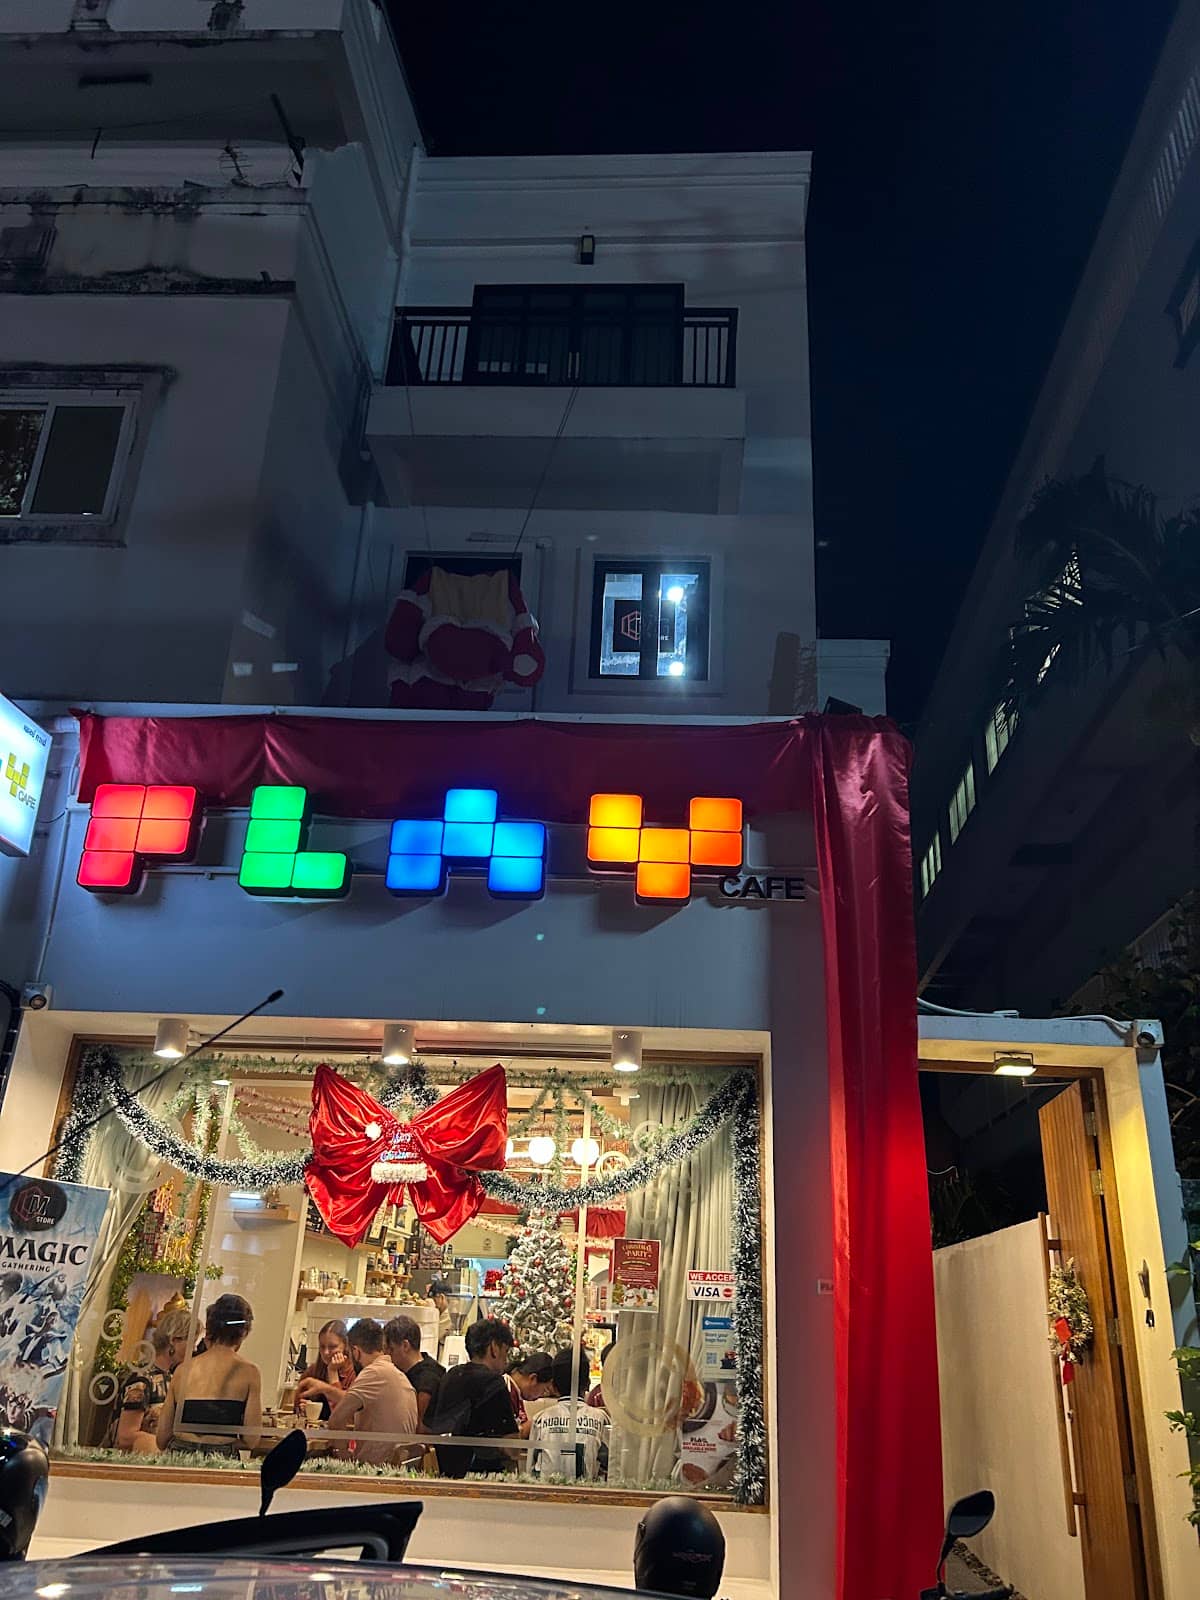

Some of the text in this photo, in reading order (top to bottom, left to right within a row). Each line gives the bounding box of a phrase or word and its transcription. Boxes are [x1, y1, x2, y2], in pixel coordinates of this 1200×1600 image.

[18, 790, 36, 810] CAFE
[77, 783, 744, 906] PLAY
[719, 875, 806, 899] CAFE
[36, 1216, 55, 1225] STORE
[0, 1235, 88, 1266] MAGIC
[627, 1249, 648, 1258] PARTY
[2, 1261, 51, 1273] GATHERING
[689, 1273, 734, 1281] WE ACCEP
[693, 1286, 720, 1298] VISA
